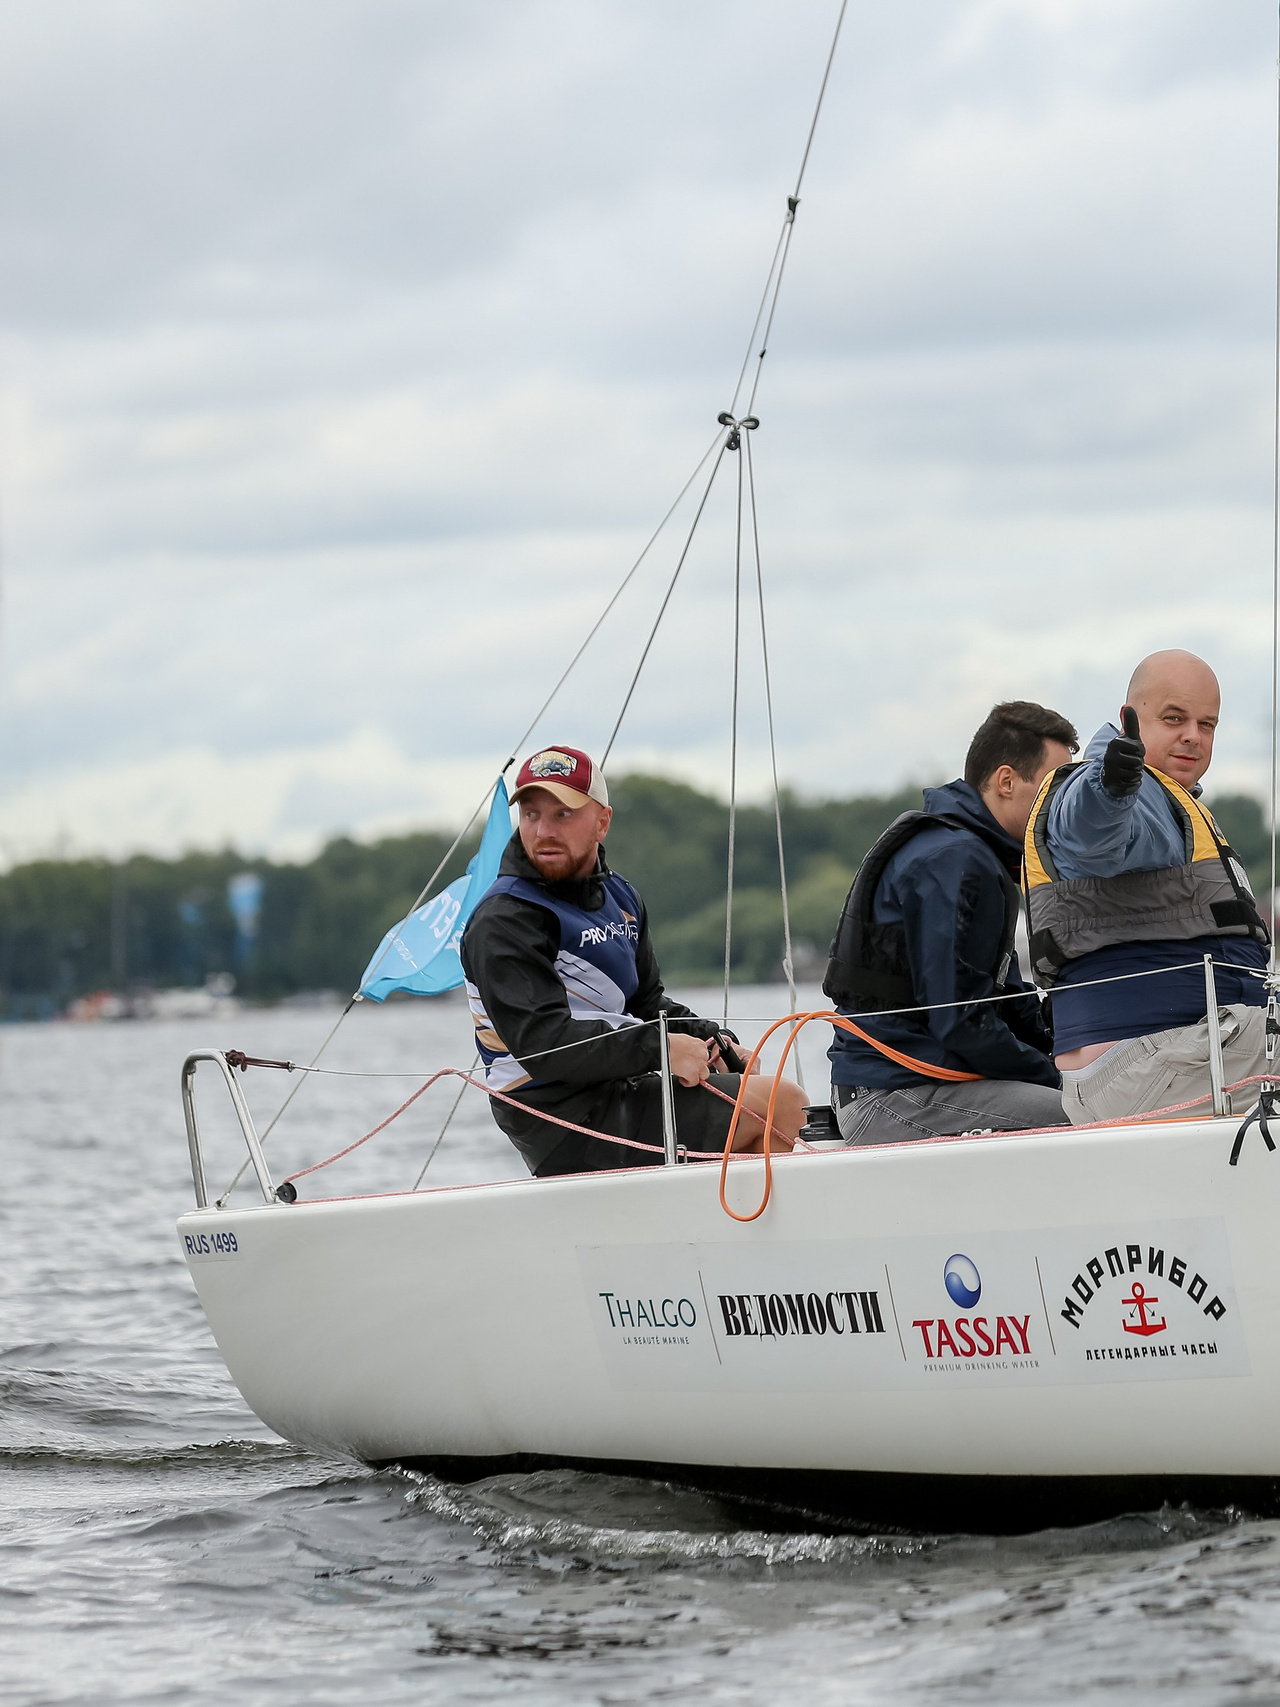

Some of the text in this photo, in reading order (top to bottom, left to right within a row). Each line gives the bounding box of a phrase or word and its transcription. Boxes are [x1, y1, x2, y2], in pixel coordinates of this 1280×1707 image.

[184, 1232, 238, 1255] RUS 1499
[1060, 1244, 1227, 1329] МОРПРИБОР
[599, 1292, 697, 1328] THALGO
[717, 1291, 886, 1342] ВЕДОМОСТИ
[623, 1335, 690, 1345] LA BEAUTÉ MARINE
[912, 1315, 1032, 1358] TASSAY
[1086, 1341, 1218, 1360] ЛЕГЕНДАРНЫЕ ЧАСЫ
[924, 1359, 1040, 1372] PREMIUM DRINKING WATER
